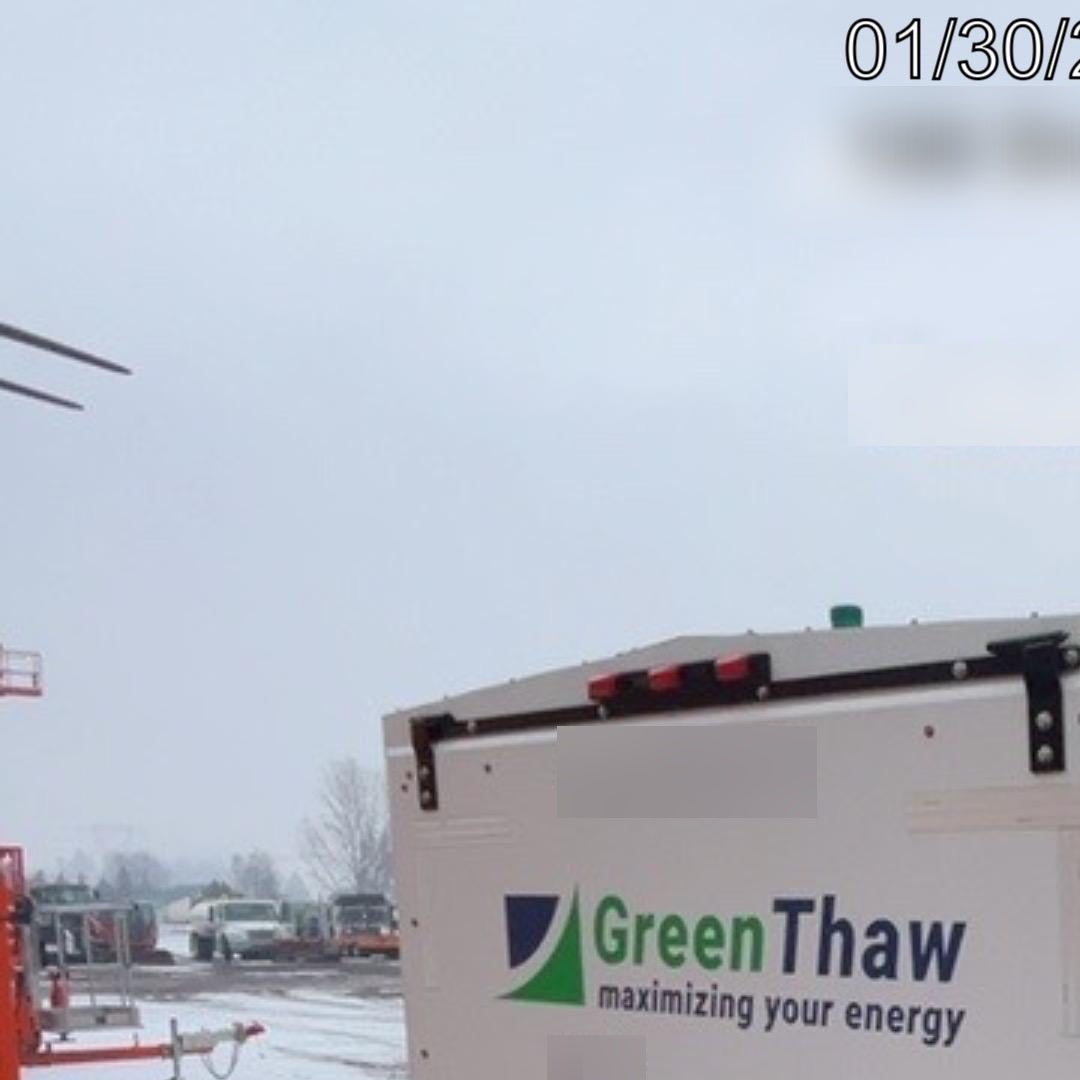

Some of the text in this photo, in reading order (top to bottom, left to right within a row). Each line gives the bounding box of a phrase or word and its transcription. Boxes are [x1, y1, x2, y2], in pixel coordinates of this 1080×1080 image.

[598, 978, 967, 1048] maximizing your energy
